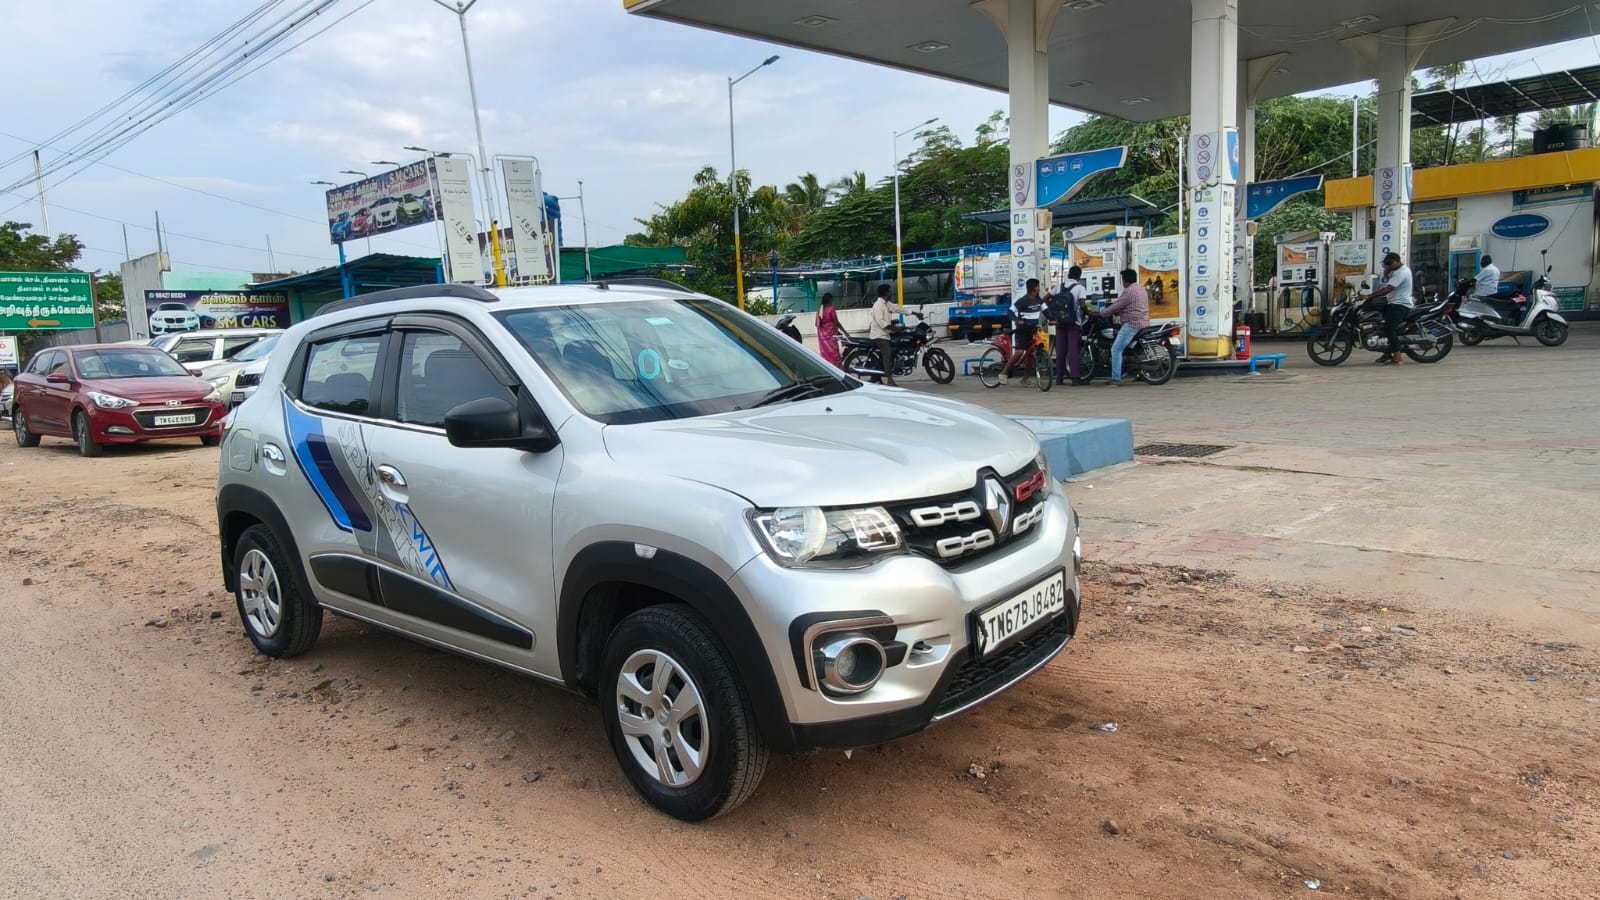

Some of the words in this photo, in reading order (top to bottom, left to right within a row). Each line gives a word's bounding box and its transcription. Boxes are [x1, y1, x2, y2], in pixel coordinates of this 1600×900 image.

[403, 162, 425, 179] CARS
[217, 316, 238, 329] SM
[241, 315, 277, 328] CARS
[988, 579, 1063, 644] TN67BJ8482
